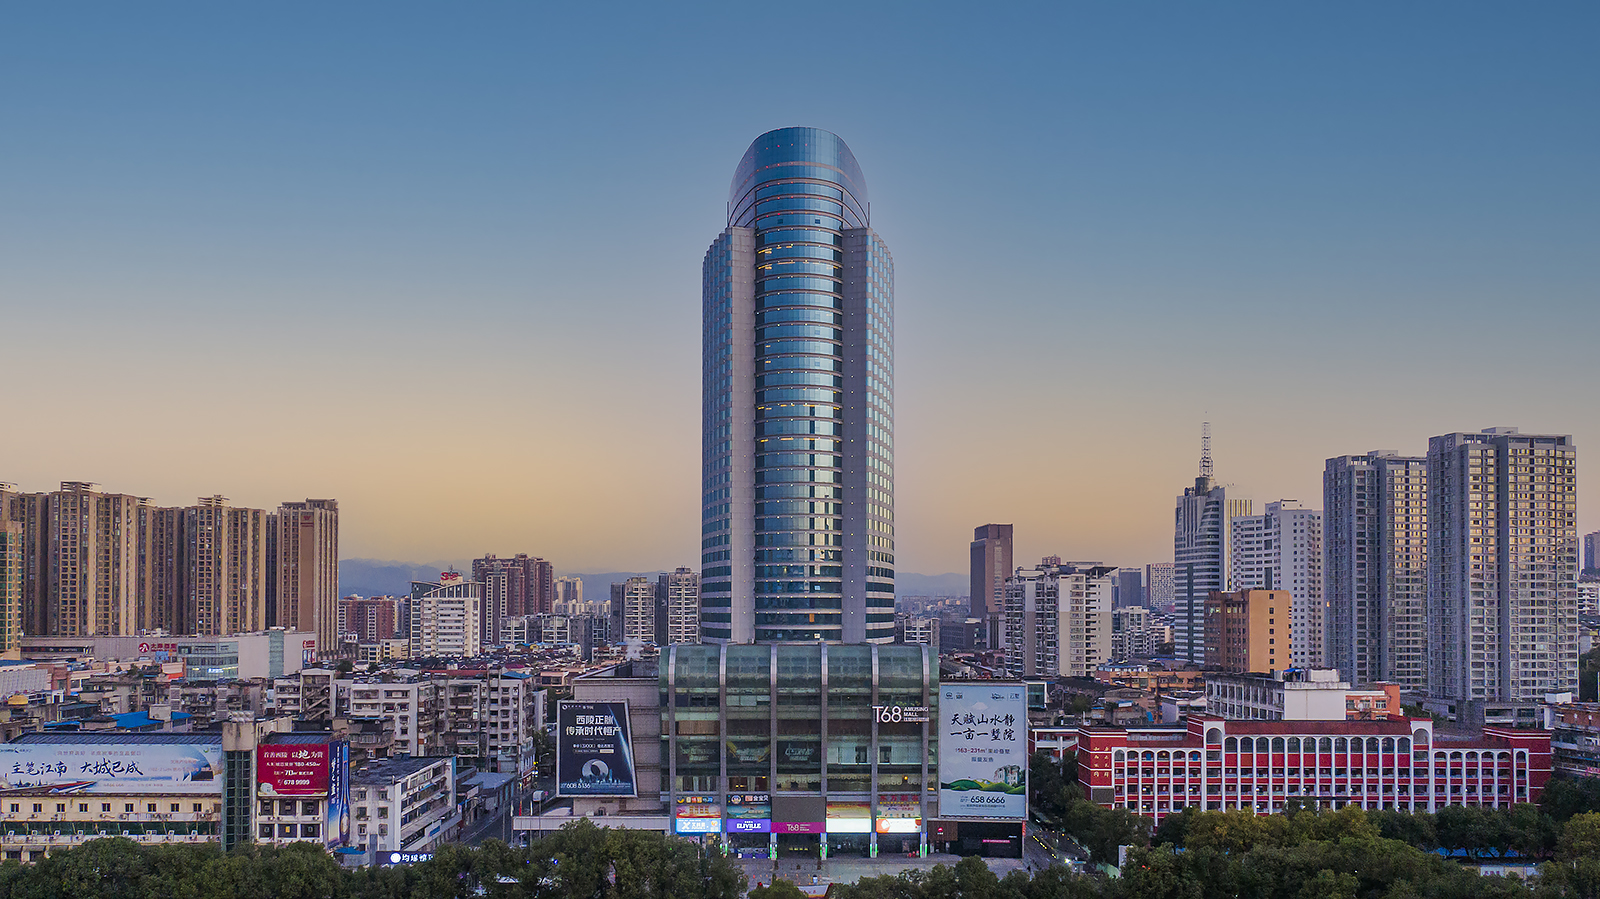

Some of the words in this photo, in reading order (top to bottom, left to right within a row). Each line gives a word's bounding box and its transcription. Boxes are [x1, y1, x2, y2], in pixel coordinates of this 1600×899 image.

[872, 705, 902, 723] T68
[950, 712, 1016, 727] 天赋山水静
[566, 726, 622, 736] 传承时代恒产
[950, 728, 1016, 741] 一亩一墅院
[11, 761, 67, 778] 主笔江南
[80, 757, 144, 778] 大城已成
[970, 795, 985, 804] 658
[985, 796, 1006, 804] 6666
